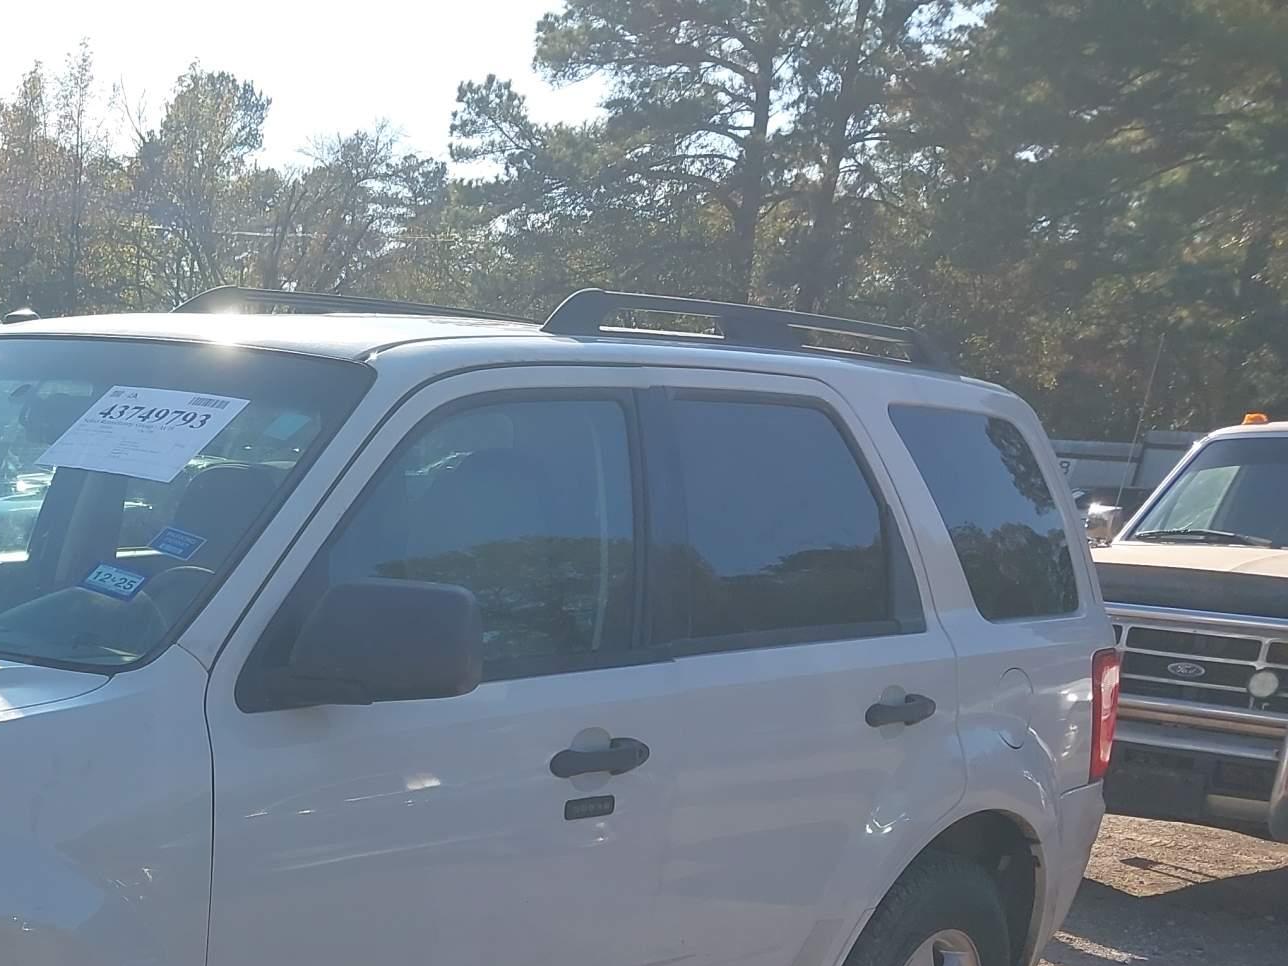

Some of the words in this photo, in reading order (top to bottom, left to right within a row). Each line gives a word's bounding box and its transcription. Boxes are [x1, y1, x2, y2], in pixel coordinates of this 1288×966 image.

[99, 404, 211, 429] 43749793
[92, 570, 111, 583] 12
[115, 577, 137, 590] 25
